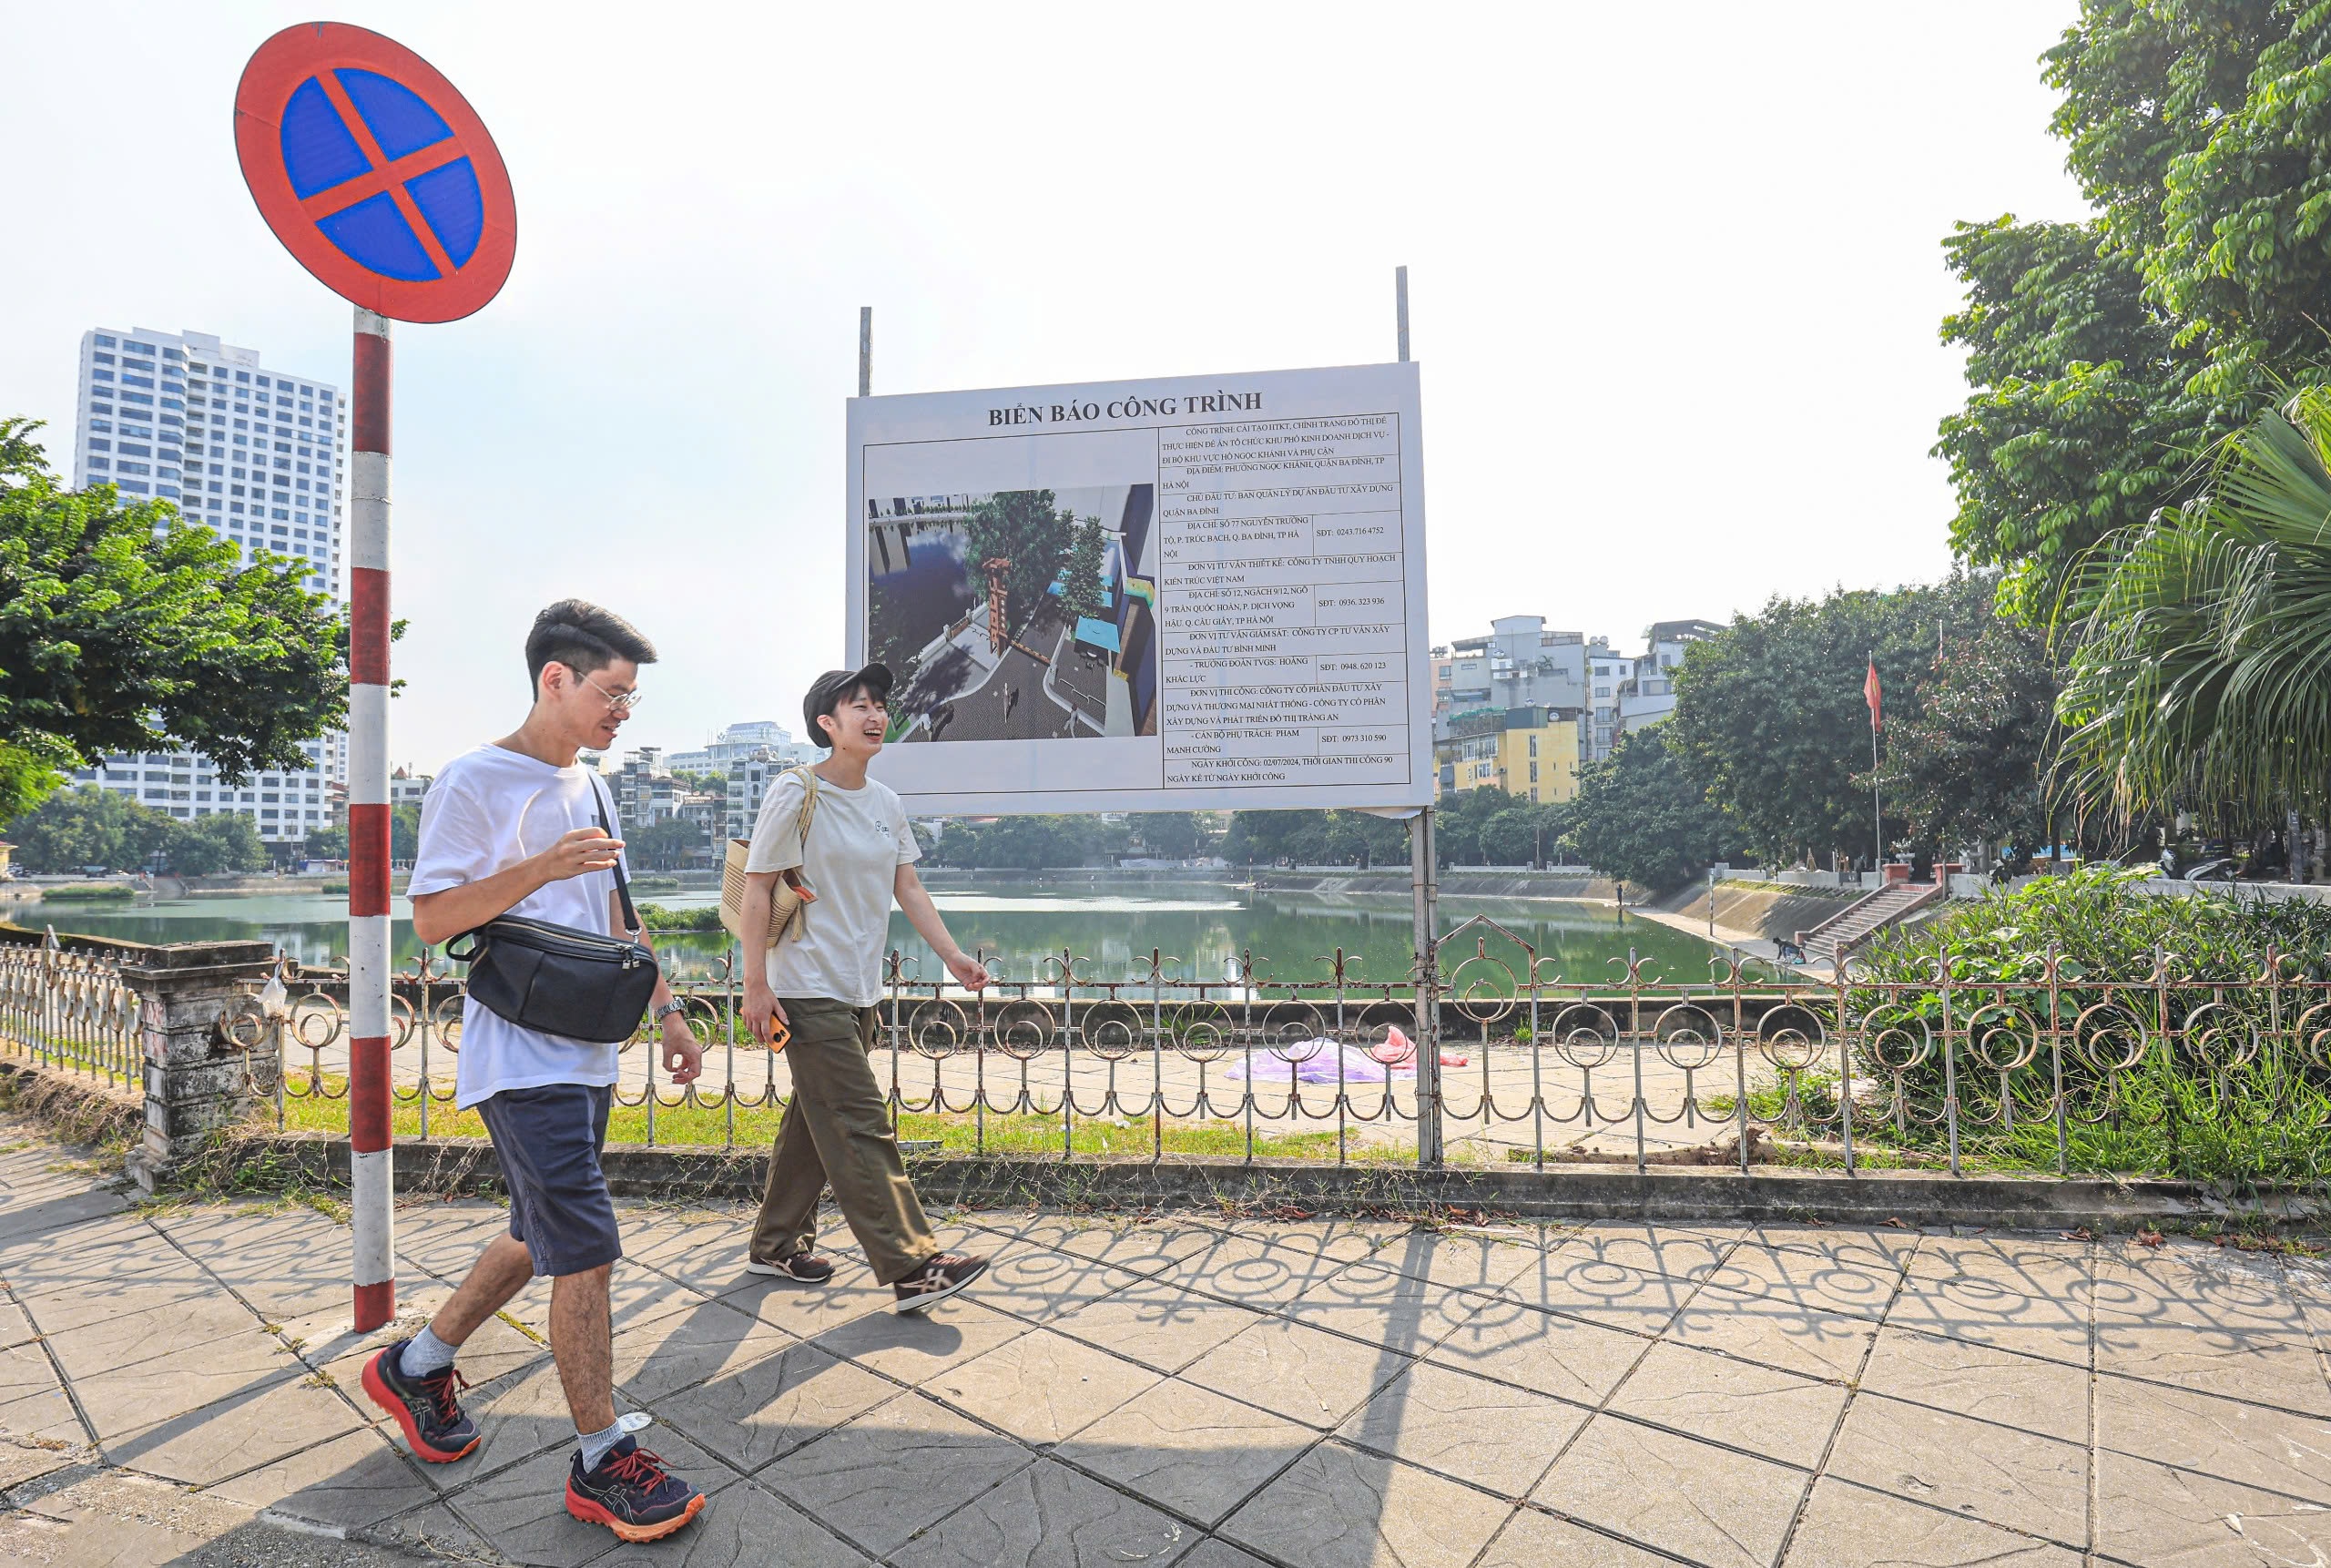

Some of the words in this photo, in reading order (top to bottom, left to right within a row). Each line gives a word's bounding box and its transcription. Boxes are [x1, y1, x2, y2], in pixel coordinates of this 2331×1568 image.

[1050, 399, 1100, 422] BÁO
[1106, 395, 1177, 418] CÔNG
[1185, 390, 1263, 413] TRÌNH
[1321, 433, 1350, 441] DOANH
[1336, 527, 1367, 535] 0243.716
[1347, 555, 1365, 564] QUY
[1233, 589, 1242, 597] 12,
[1273, 587, 1289, 596] 9/12,
